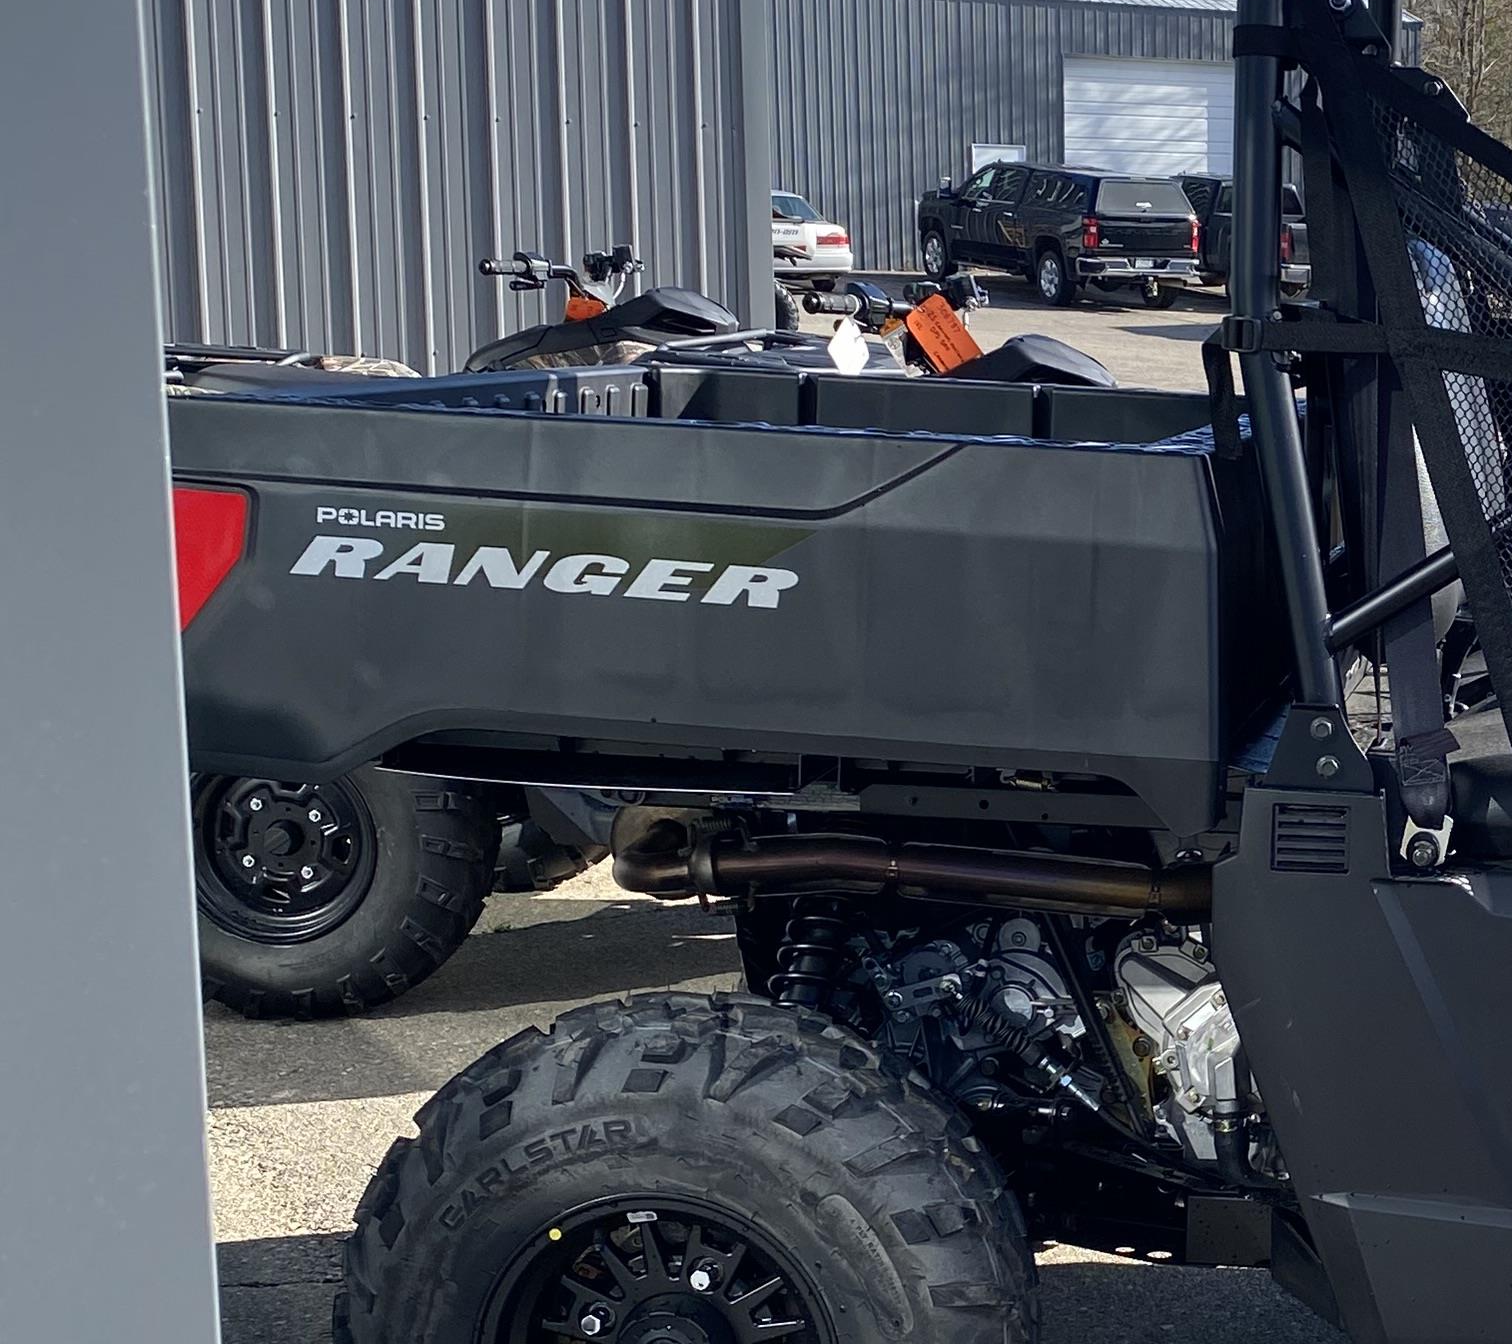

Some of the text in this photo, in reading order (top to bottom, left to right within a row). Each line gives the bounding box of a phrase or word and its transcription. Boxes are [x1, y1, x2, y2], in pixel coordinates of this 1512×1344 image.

[316, 507, 446, 531] POLARIS
[290, 535, 799, 609] RANGER
[440, 1120, 633, 1228] CARLSTAR
